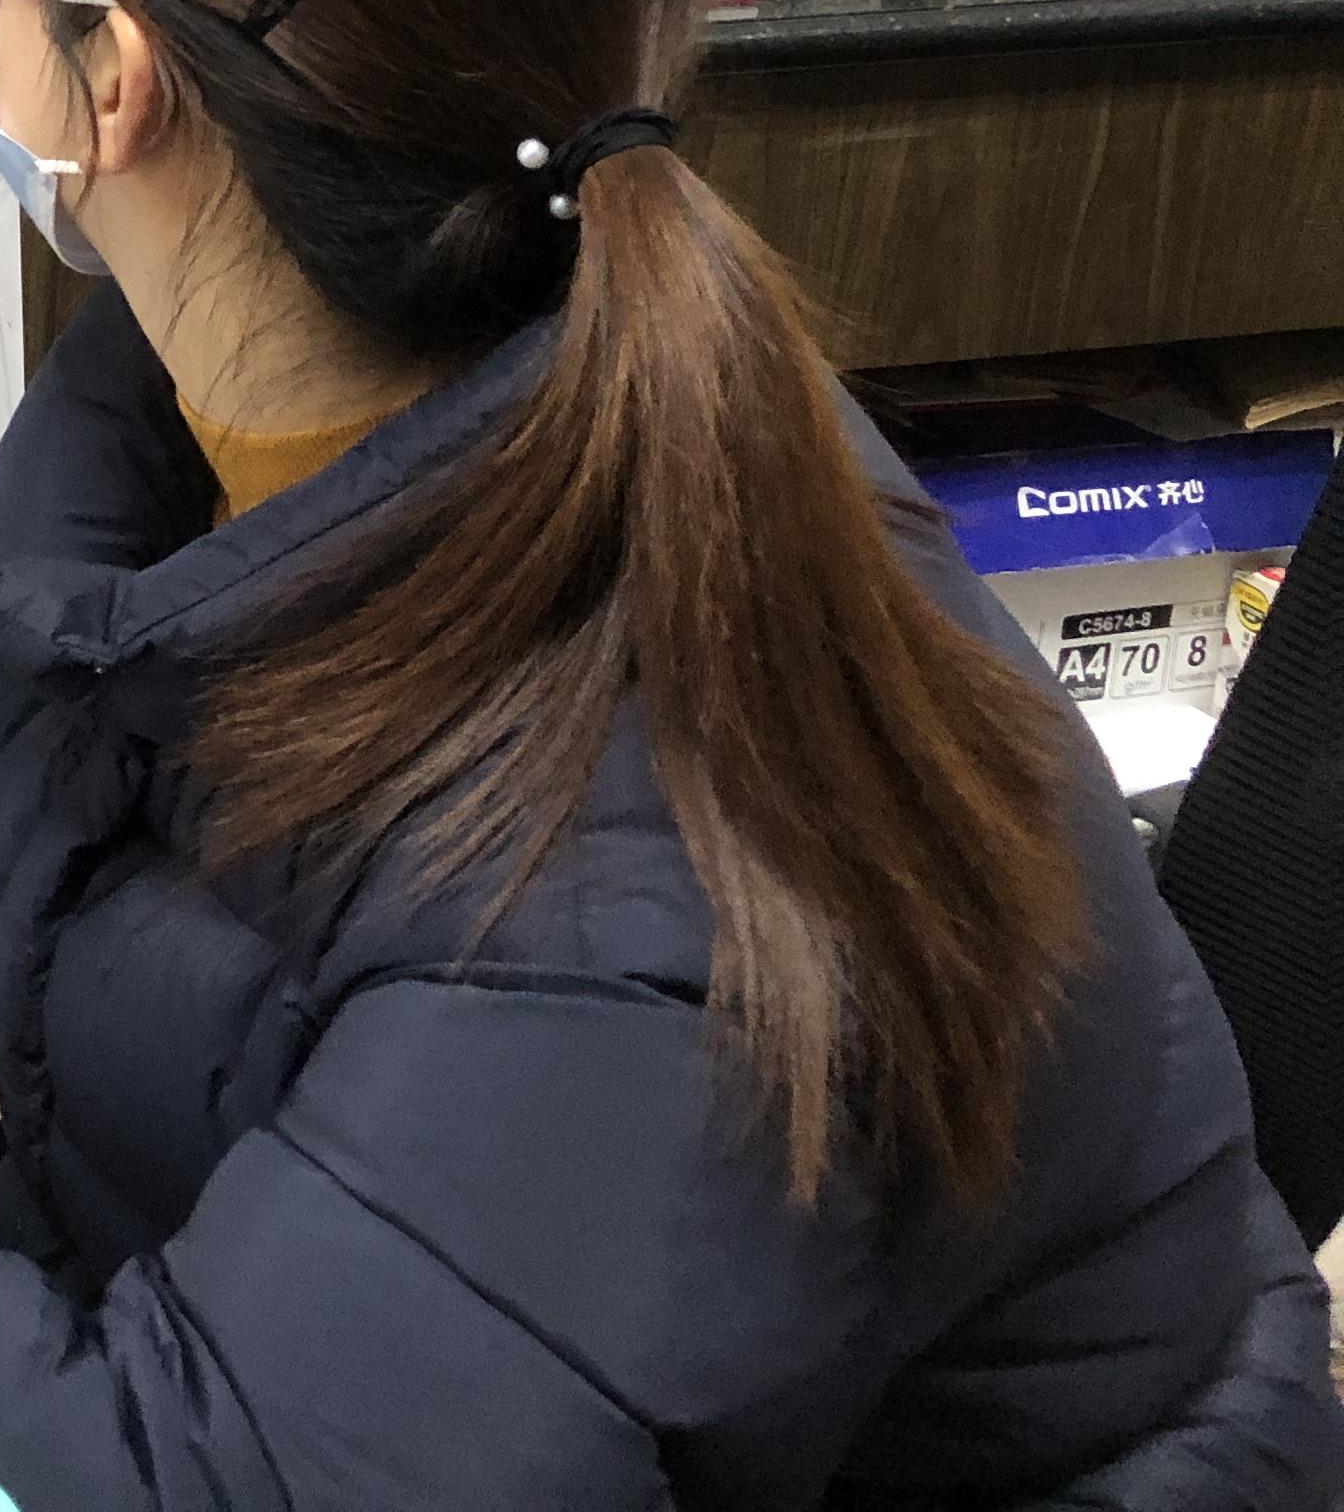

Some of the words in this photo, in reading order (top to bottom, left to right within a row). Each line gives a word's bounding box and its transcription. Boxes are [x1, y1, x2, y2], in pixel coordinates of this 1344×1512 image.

[1157, 478, 1205, 505] 齐心
[1079, 612, 1153, 635] C5674-8
[1059, 645, 1108, 683] A4
[1122, 643, 1161, 677] 70
[1187, 635, 1208, 667] 8
